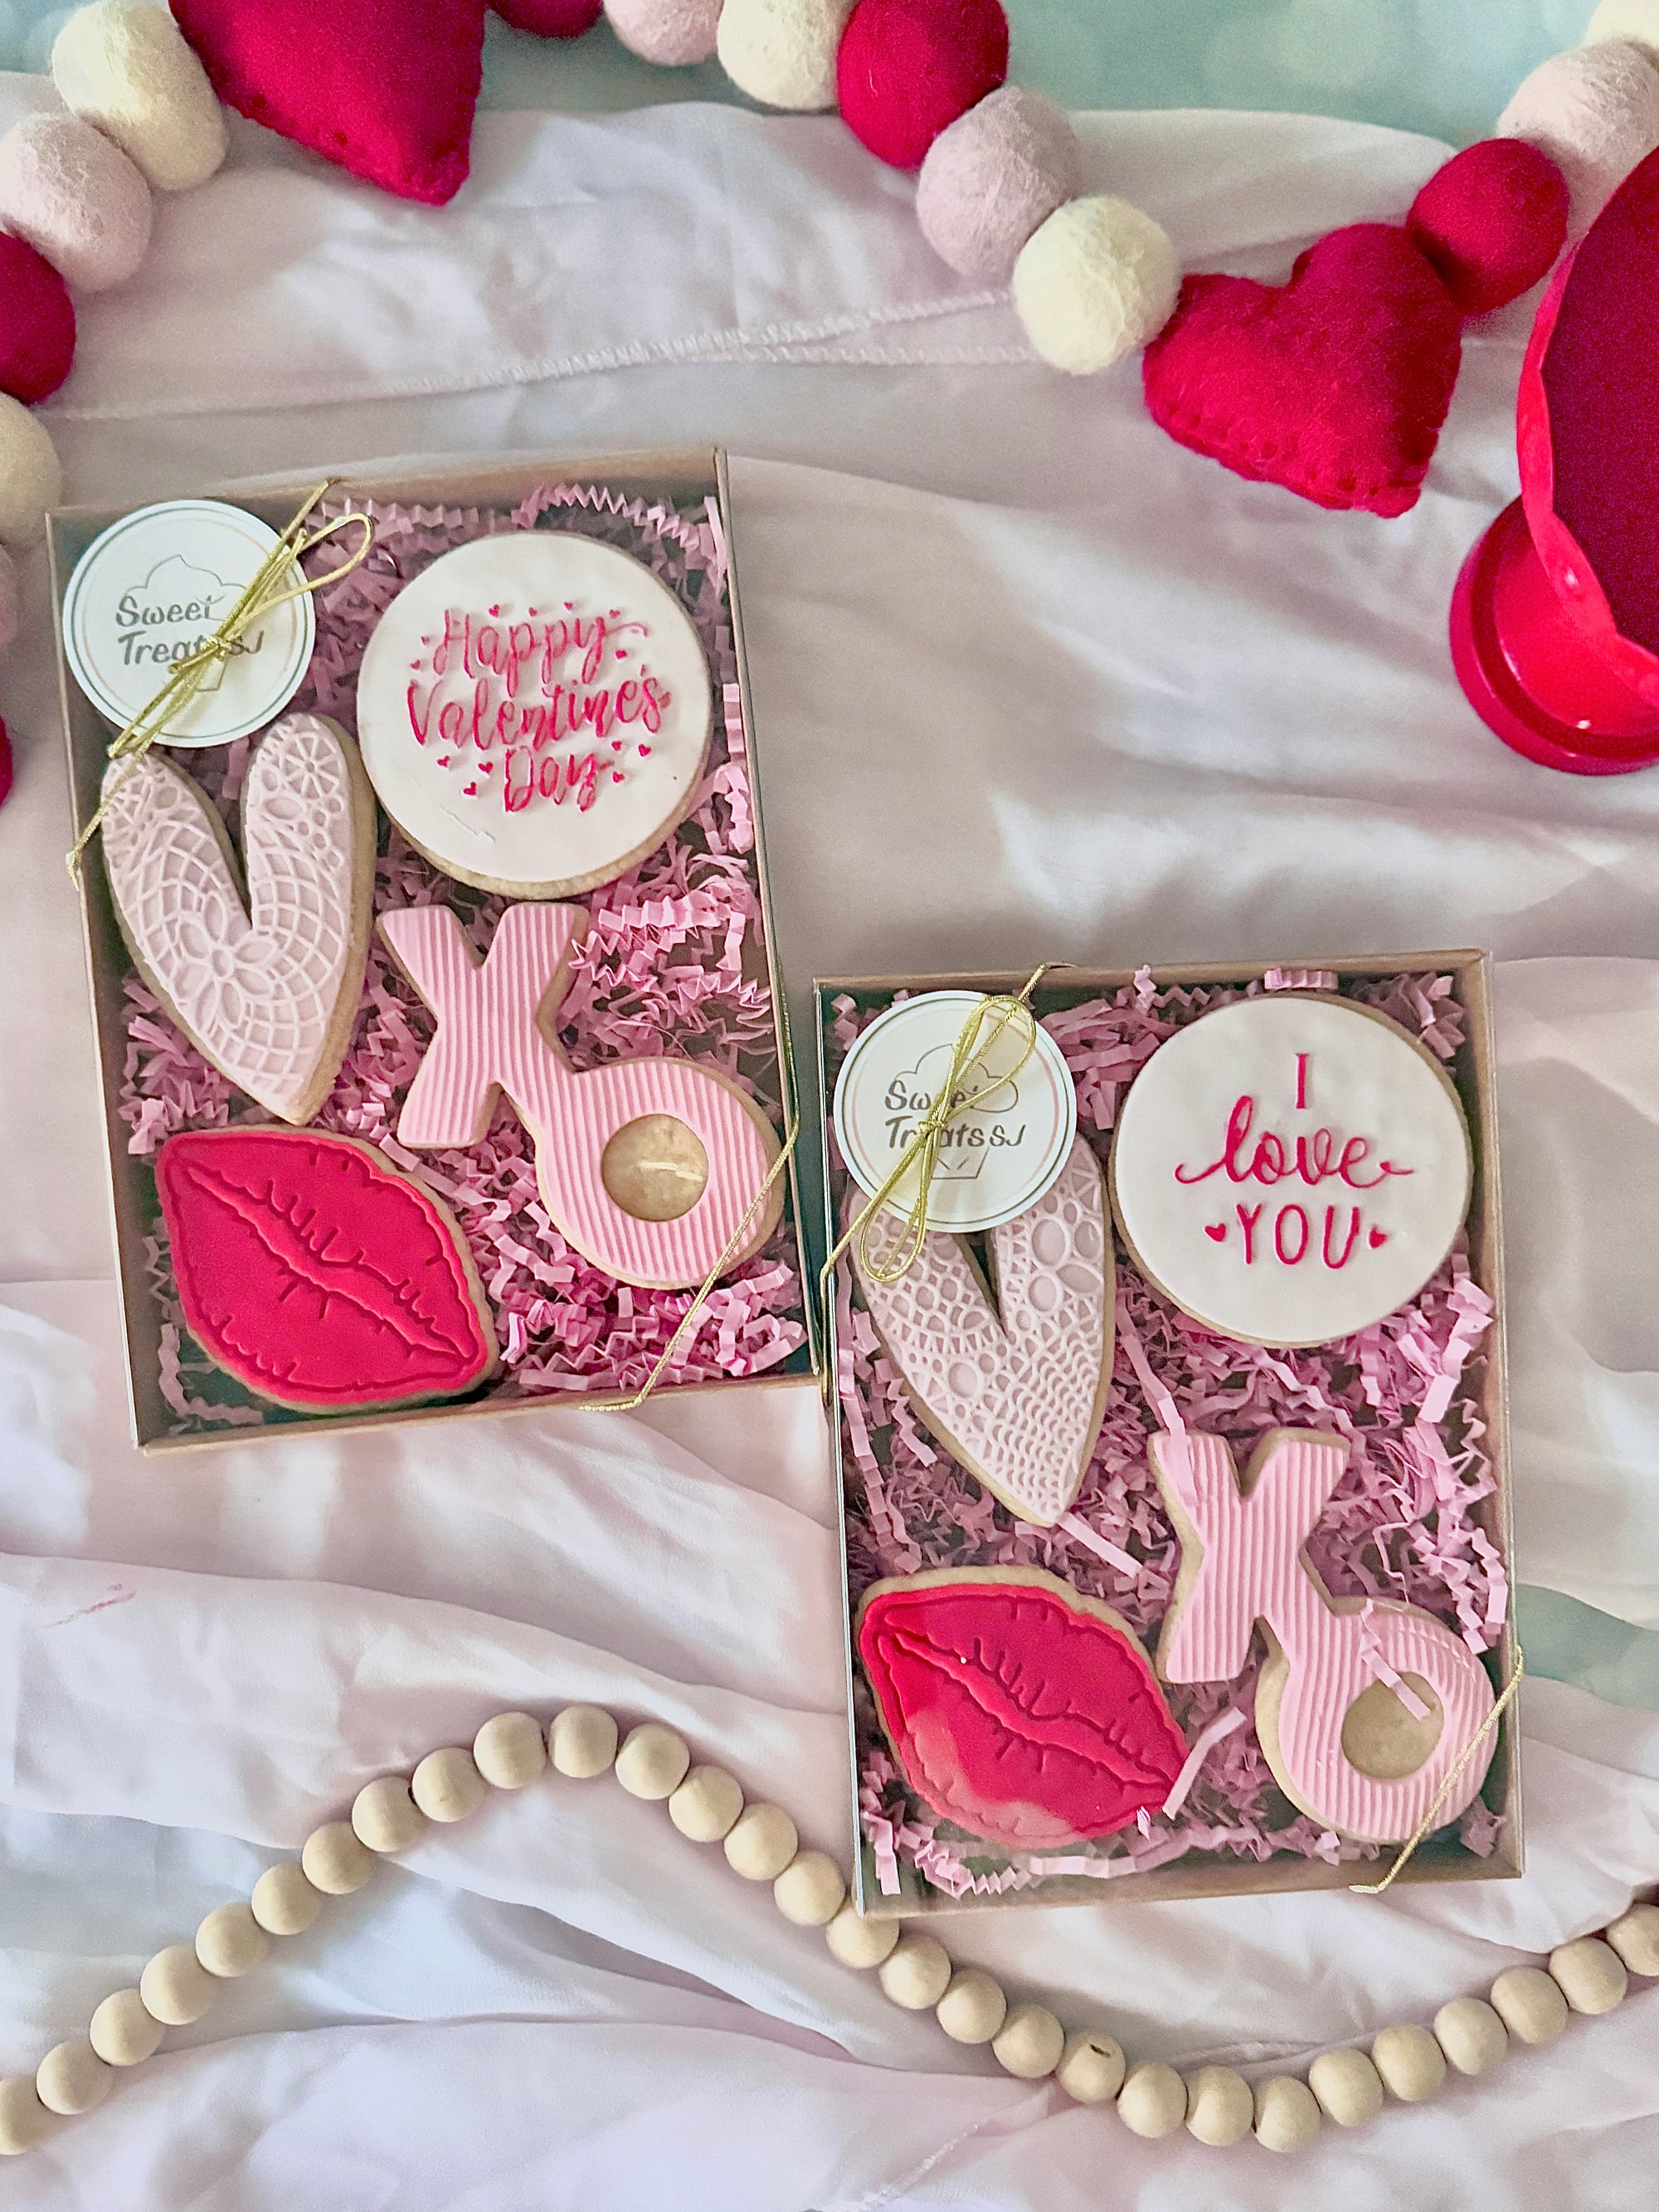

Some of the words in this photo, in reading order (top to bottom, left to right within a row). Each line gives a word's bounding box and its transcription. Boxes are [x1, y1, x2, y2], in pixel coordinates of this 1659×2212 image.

[115, 594, 213, 627] Sweet
[432, 607, 649, 698] Happy
[504, 746, 615, 812] Day
[1296, 1053, 1309, 1109] I
[1174, 1094, 1414, 1188] love
[1236, 1203, 1360, 1269] YOU
